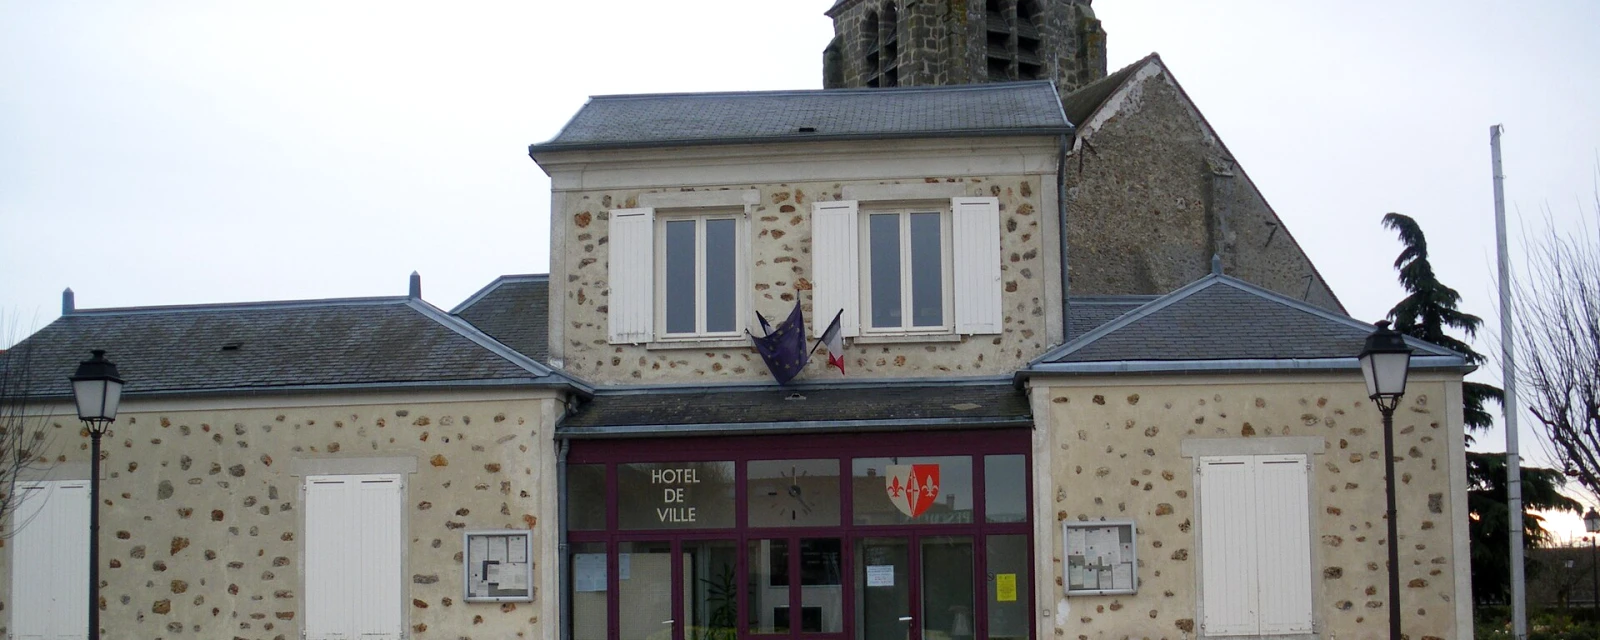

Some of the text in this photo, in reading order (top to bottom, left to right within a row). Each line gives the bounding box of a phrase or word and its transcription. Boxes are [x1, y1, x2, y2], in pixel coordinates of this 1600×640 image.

[652, 469, 700, 483] HOTEL
[664, 488, 684, 502] DE
[656, 507, 696, 522] VILLE
